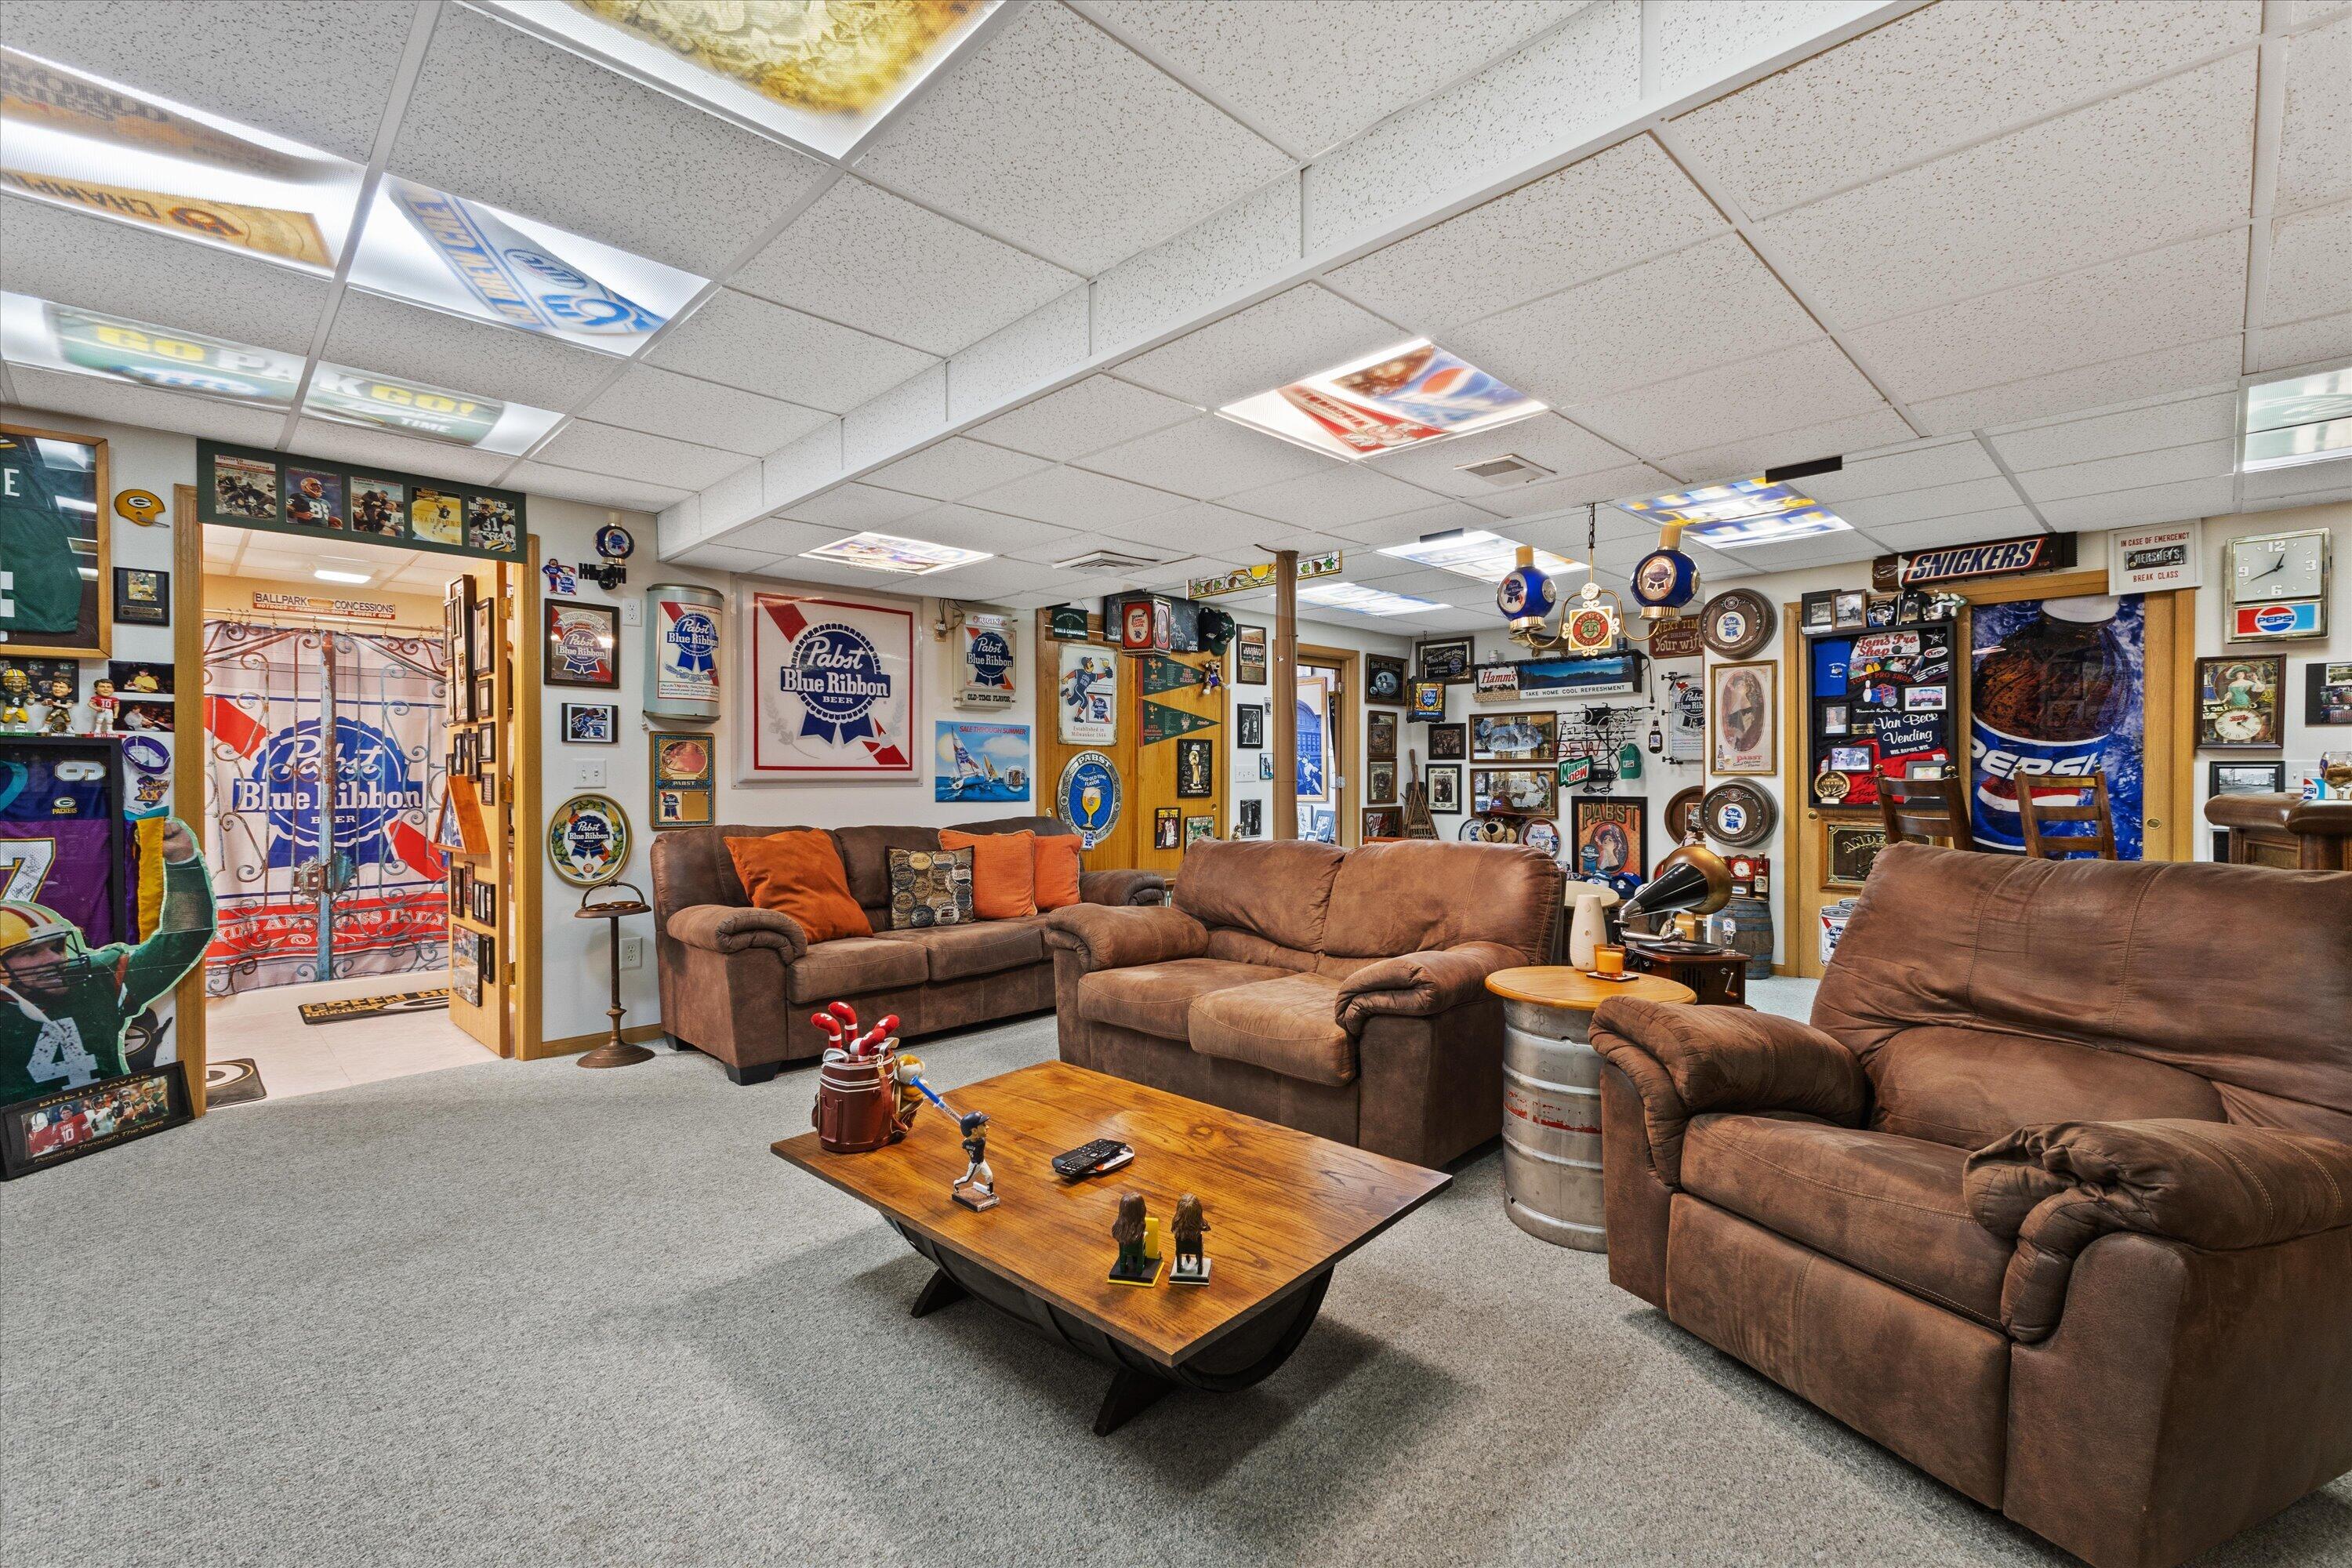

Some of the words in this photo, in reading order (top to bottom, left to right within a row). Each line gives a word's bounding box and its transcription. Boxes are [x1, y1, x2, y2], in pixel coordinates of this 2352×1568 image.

[97, 326, 204, 362] GO
[372, 385, 476, 415] GO!
[219, 455, 244, 463] Sports
[237, 461, 270, 470] Illustrated
[309, 502, 330, 519] 85
[413, 514, 460, 528] CHAMPIONS
[2129, 538, 2143, 546] CASE
[2154, 532, 2190, 543] EMERGENCY
[2268, 540, 2286, 553] 12
[1911, 541, 2038, 580] SNICKERS
[2305, 559, 2317, 571] 3
[2133, 573, 2154, 583] BREAK
[2158, 571, 2179, 579] GLASS
[2238, 566, 2249, 578] 9
[2271, 585, 2282, 596] 6
[255, 593, 307, 606] BALLPARK
[335, 600, 395, 613] CONCESSIONS
[682, 619, 710, 634] Pabst
[2257, 615, 2295, 624] PEPSI
[1656, 620, 1679, 636] NEXT
[1681, 618, 1699, 630] TIM
[569, 633, 596, 647] Pabst
[668, 632, 691, 643] Blue
[1857, 637, 1891, 648] Tom's
[1892, 633, 1918, 644] Pro
[558, 645, 577, 654] Blue
[577, 647, 606, 657] Ribbon
[978, 637, 1004, 654] Pabst
[1858, 646, 1891, 659] Shop
[806, 636, 866, 670] Pabst
[967, 652, 985, 665] Blue
[985, 655, 1013, 667] Ribbon
[782, 668, 825, 693] Blue
[826, 672, 888, 697] Ribbon
[1481, 670, 1517, 684] Hamm's
[1892, 673, 1914, 684] SHOP
[1581, 684, 1625, 693] REFRESHMENT
[13, 697, 20, 706] 4
[822, 695, 854, 704] BEER
[1424, 695, 1436, 706] Style
[1685, 691, 1703, 702] Pabs
[1874, 717, 1901, 730] Van
[1882, 728, 1933, 745] Vending
[1078, 753, 1112, 768] PABST
[235, 779, 310, 811] Blue
[310, 815, 356, 824] BER
[1582, 803, 1641, 832] PABST
[577, 821, 601, 832] Pabst
[1843, 833, 1886, 854] ANDE
[27, 1017, 100, 1091] 4
[61, 1129, 74, 1143] 10
[78, 1134, 119, 1150] Through
[122, 1128, 139, 1137] The
[140, 1120, 164, 1131] Years
